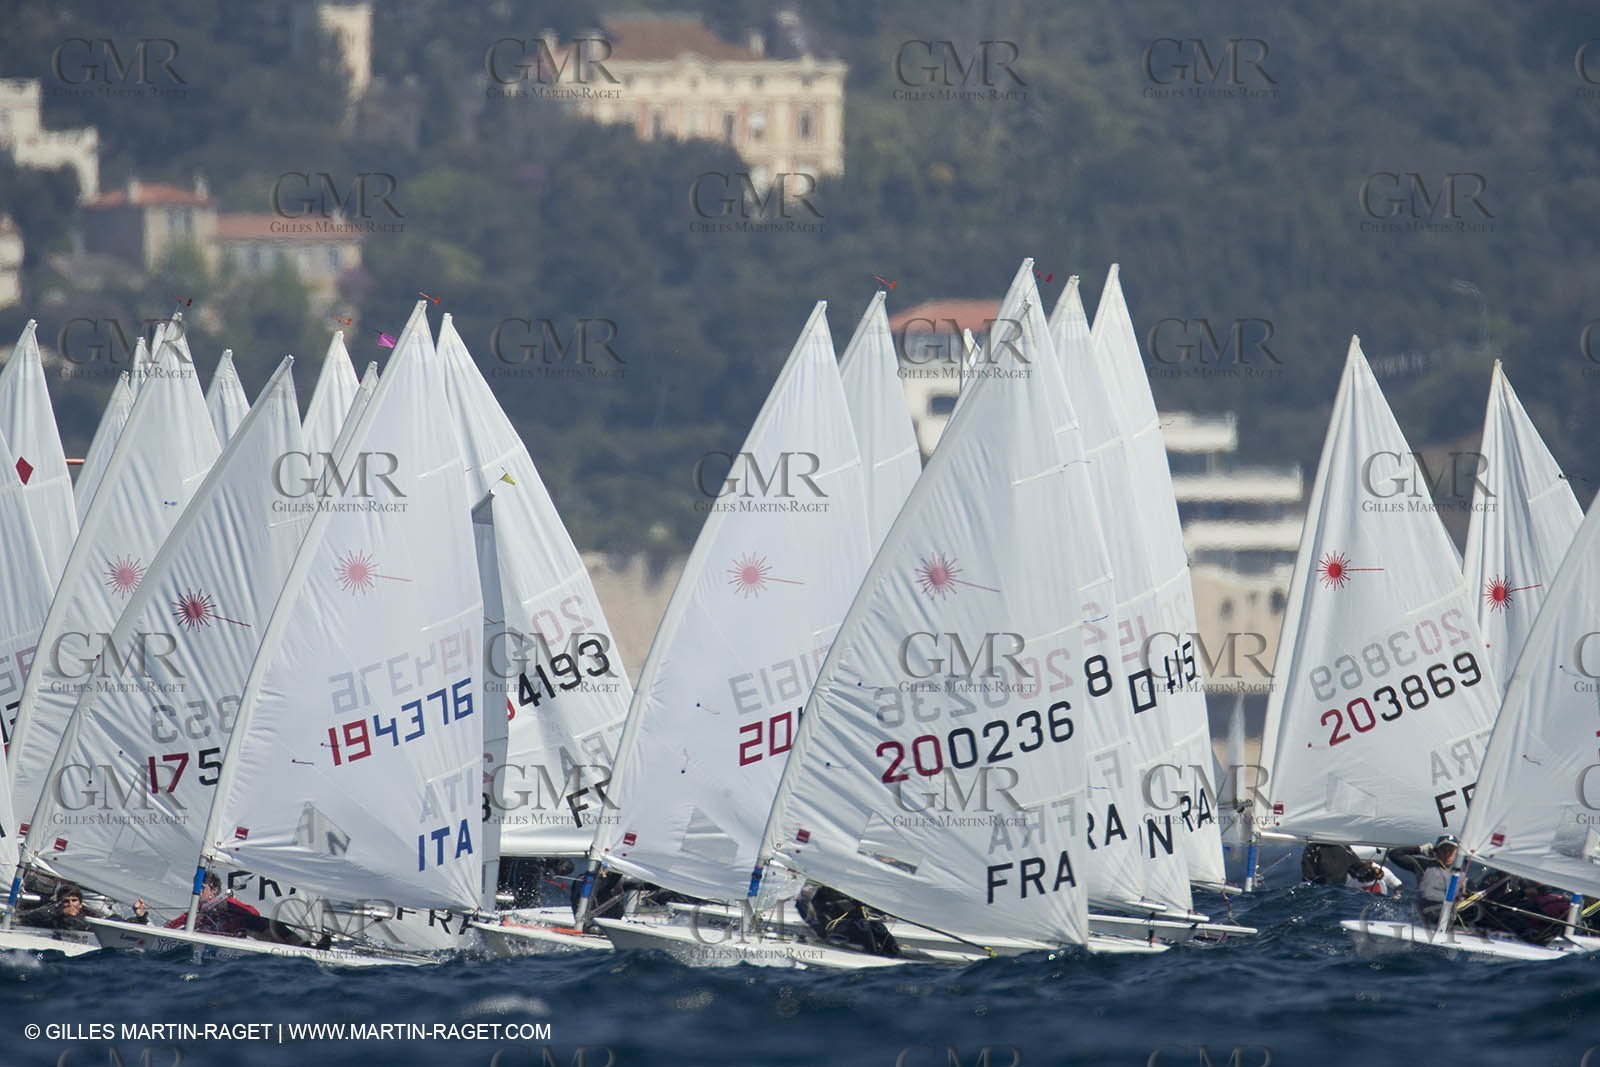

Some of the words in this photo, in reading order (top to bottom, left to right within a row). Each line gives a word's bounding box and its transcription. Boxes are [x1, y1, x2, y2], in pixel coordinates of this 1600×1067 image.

[507, 639, 610, 721] 4193
[1084, 654, 1112, 697] 8
[1320, 651, 1482, 746] 203869
[327, 677, 474, 766] 194376
[875, 701, 1074, 783] 200236
[148, 747, 223, 794] 175
[418, 818, 474, 872] ITA
[987, 851, 1077, 904] FRA
